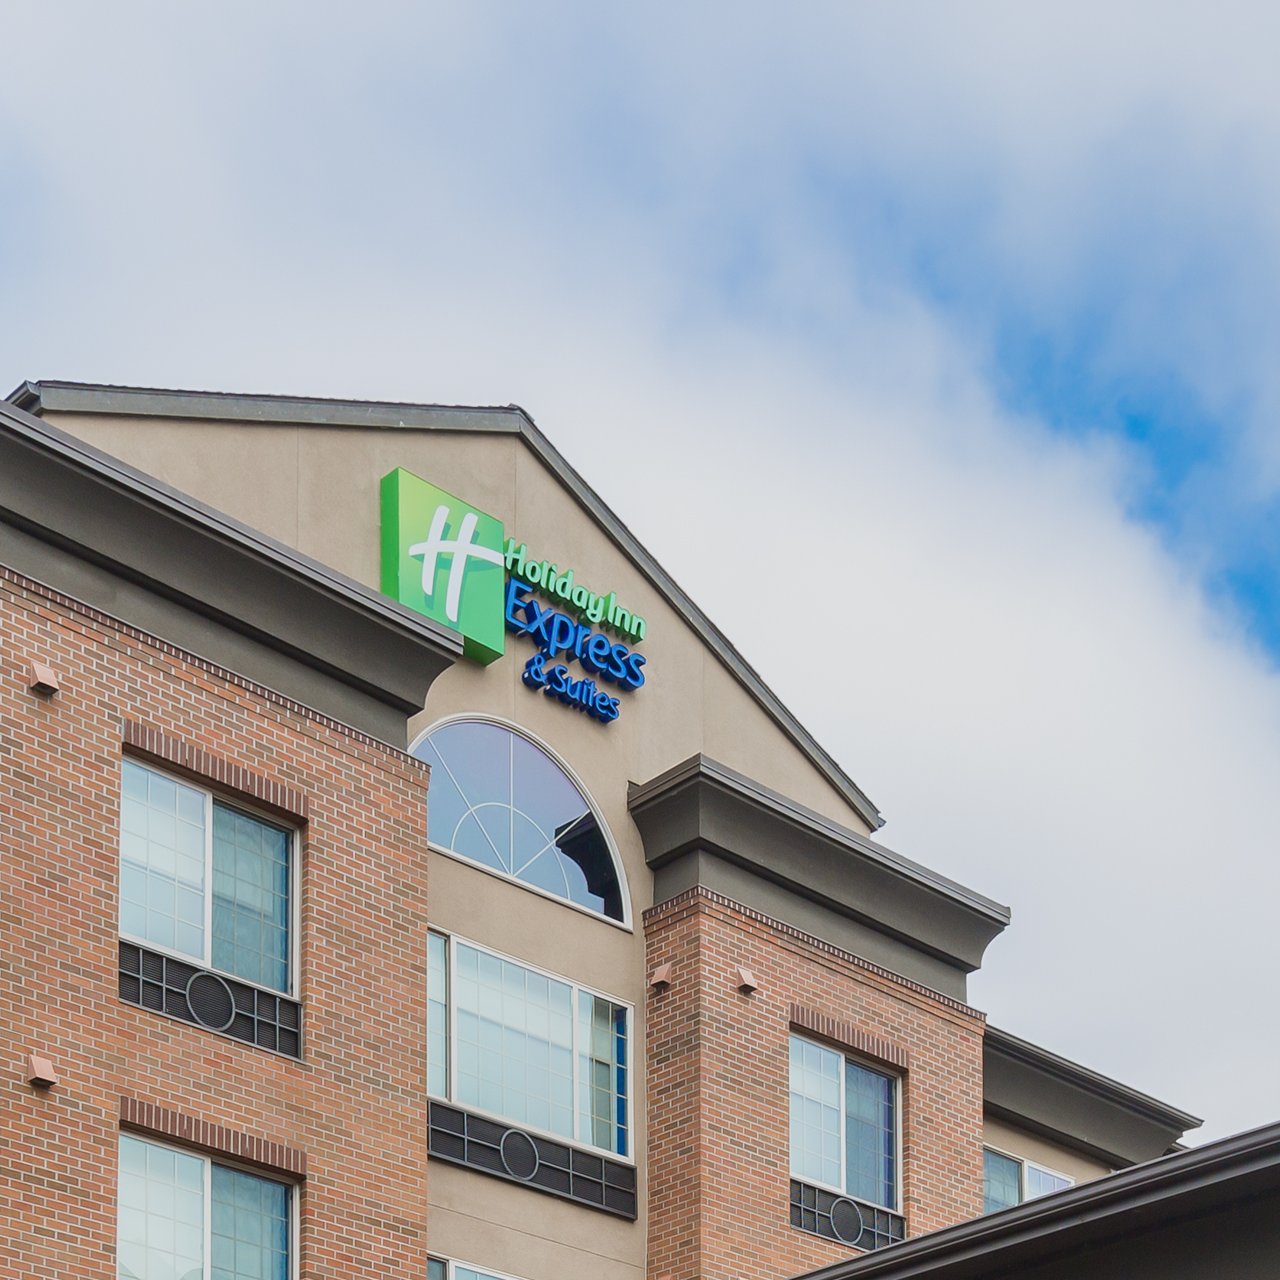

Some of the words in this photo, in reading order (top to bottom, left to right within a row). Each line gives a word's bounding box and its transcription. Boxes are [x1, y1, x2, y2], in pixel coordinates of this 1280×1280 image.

[408, 504, 505, 623] H
[504, 537, 605, 623] Holiday
[606, 591, 646, 640] Inn
[505, 577, 647, 689] Express
[525, 653, 548, 688] &
[550, 664, 621, 720] Suites
